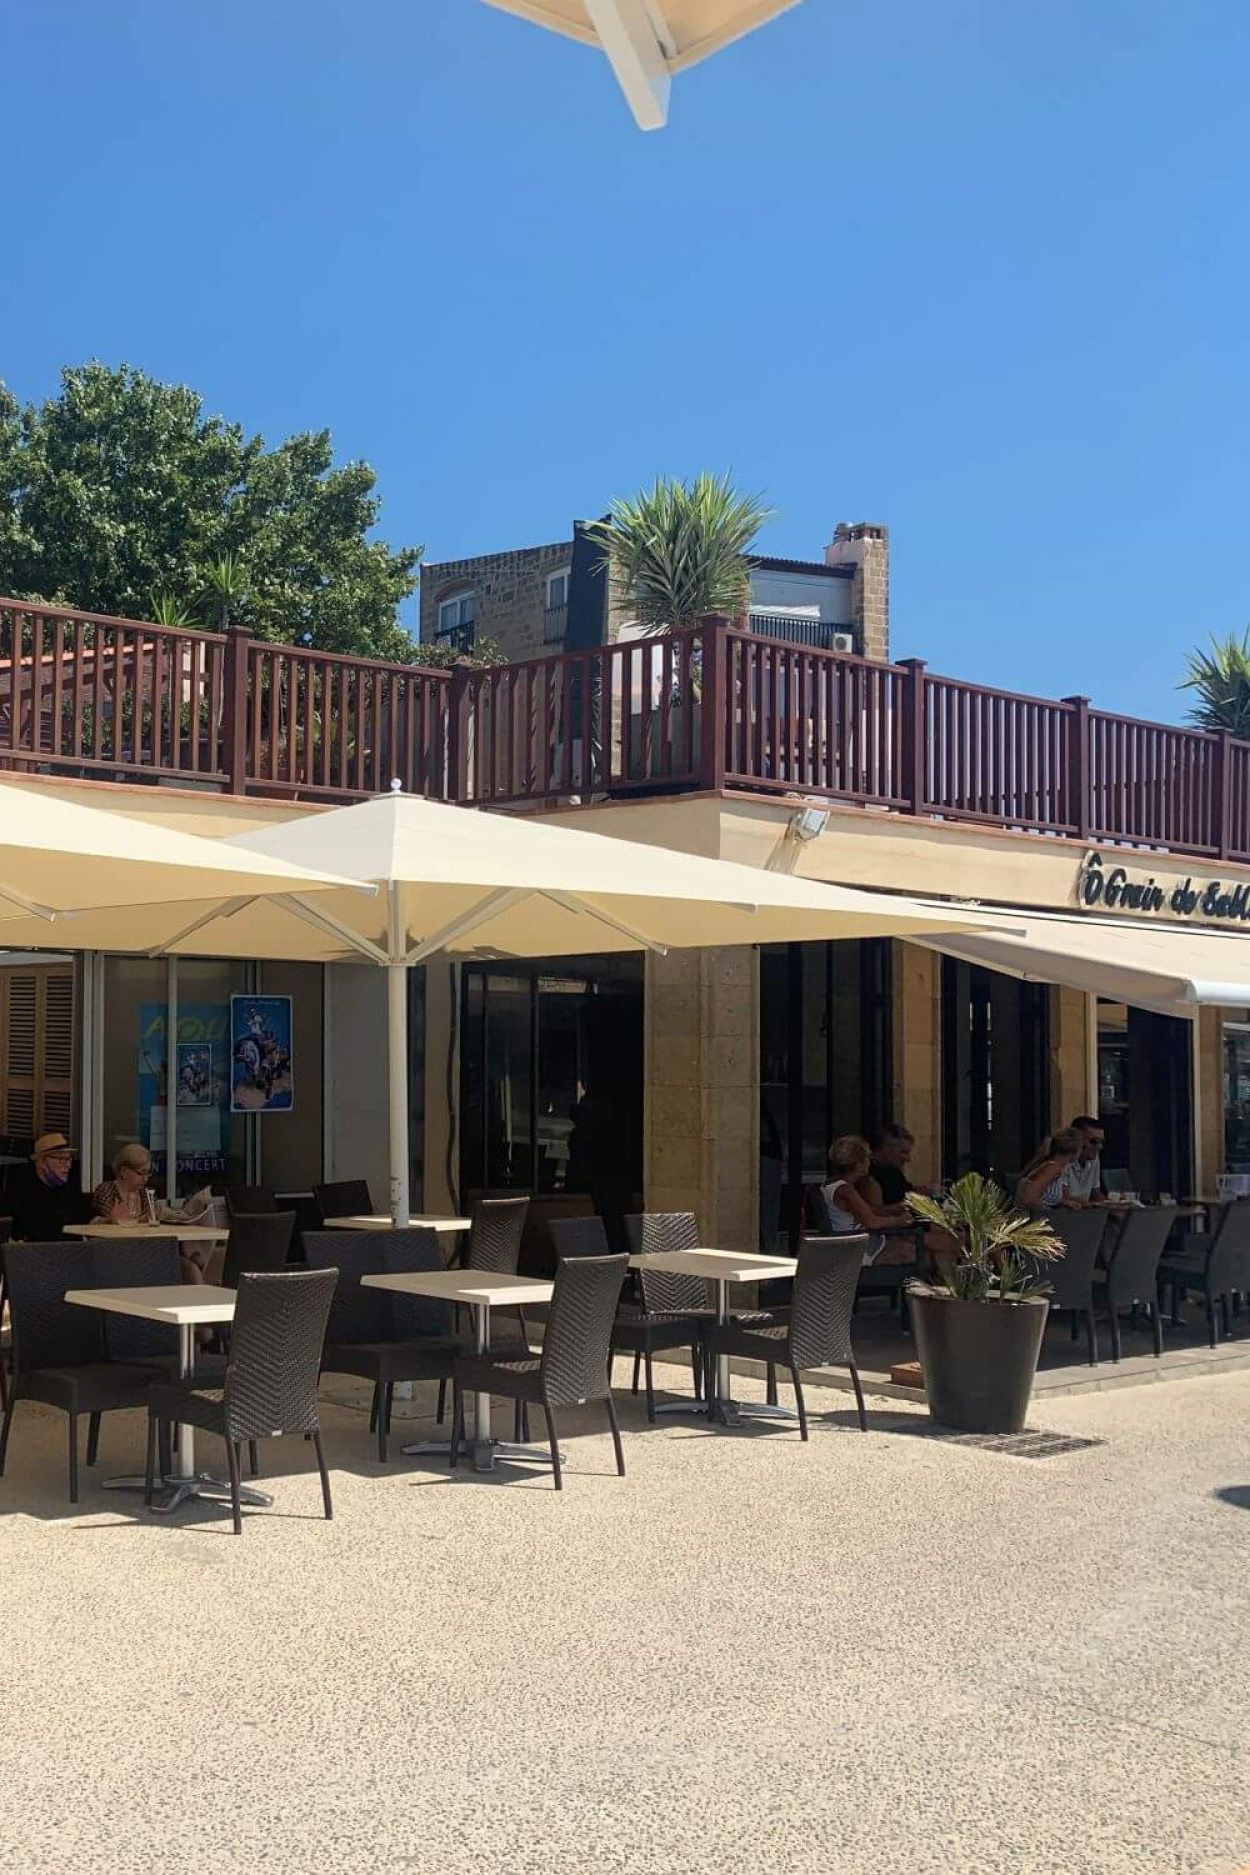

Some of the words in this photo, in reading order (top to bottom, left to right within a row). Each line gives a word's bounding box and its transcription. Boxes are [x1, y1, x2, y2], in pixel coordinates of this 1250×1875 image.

[1083, 851, 1103, 906] Ô
[1105, 868, 1165, 911] Grain
[1171, 878, 1198, 915] de
[1203, 881, 1250, 920] Sabl
[175, 1158, 228, 1173] ONCERT
